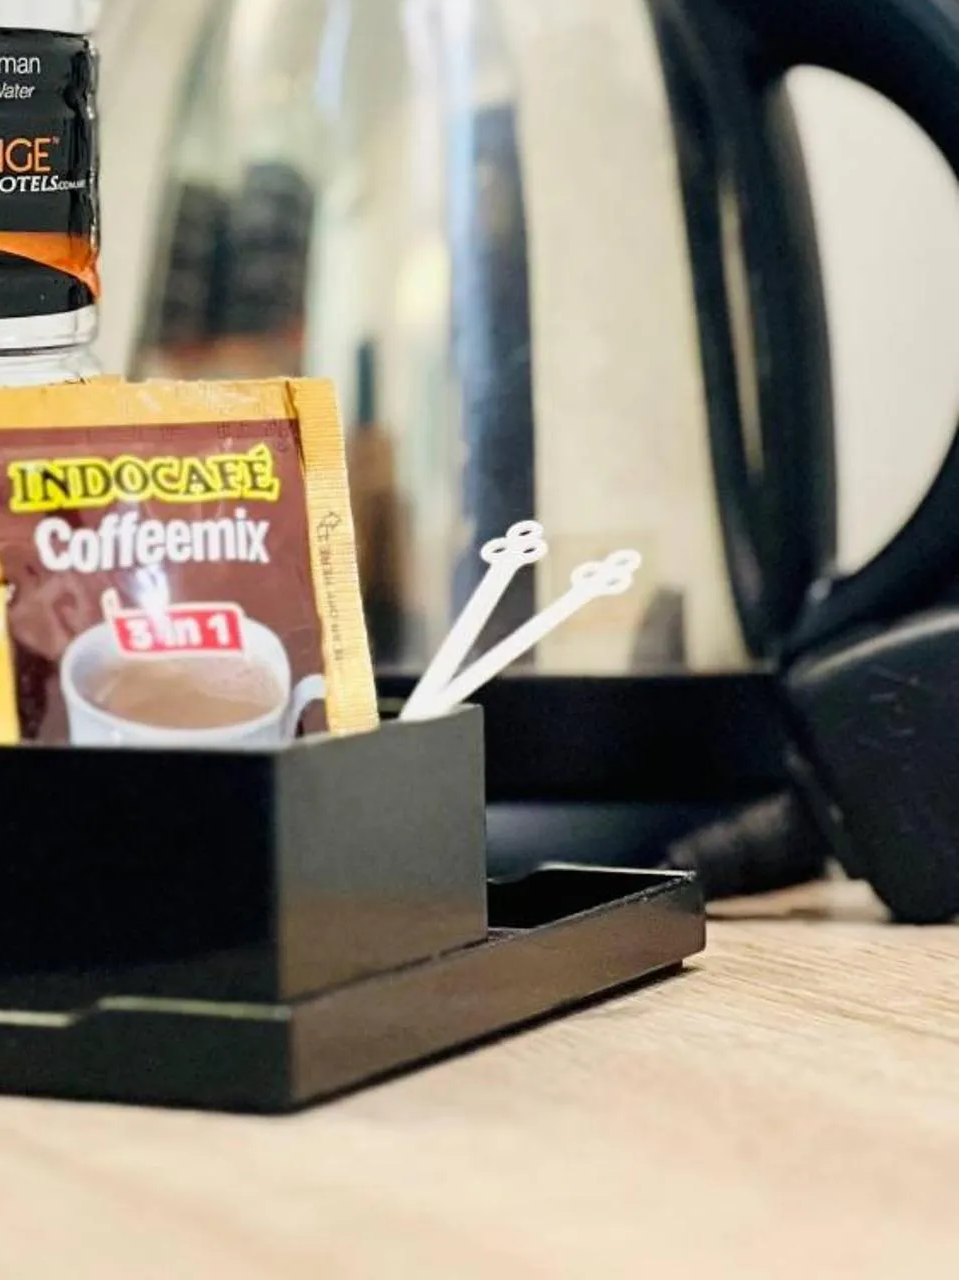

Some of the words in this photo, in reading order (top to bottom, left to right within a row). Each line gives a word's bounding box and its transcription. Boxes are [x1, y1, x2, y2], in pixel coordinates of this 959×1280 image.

[15, 443, 277, 505] INDOCAFÉ
[34, 507, 270, 573] Coffeemix
[126, 618, 153, 650] 3
[208, 614, 230, 645] 1
